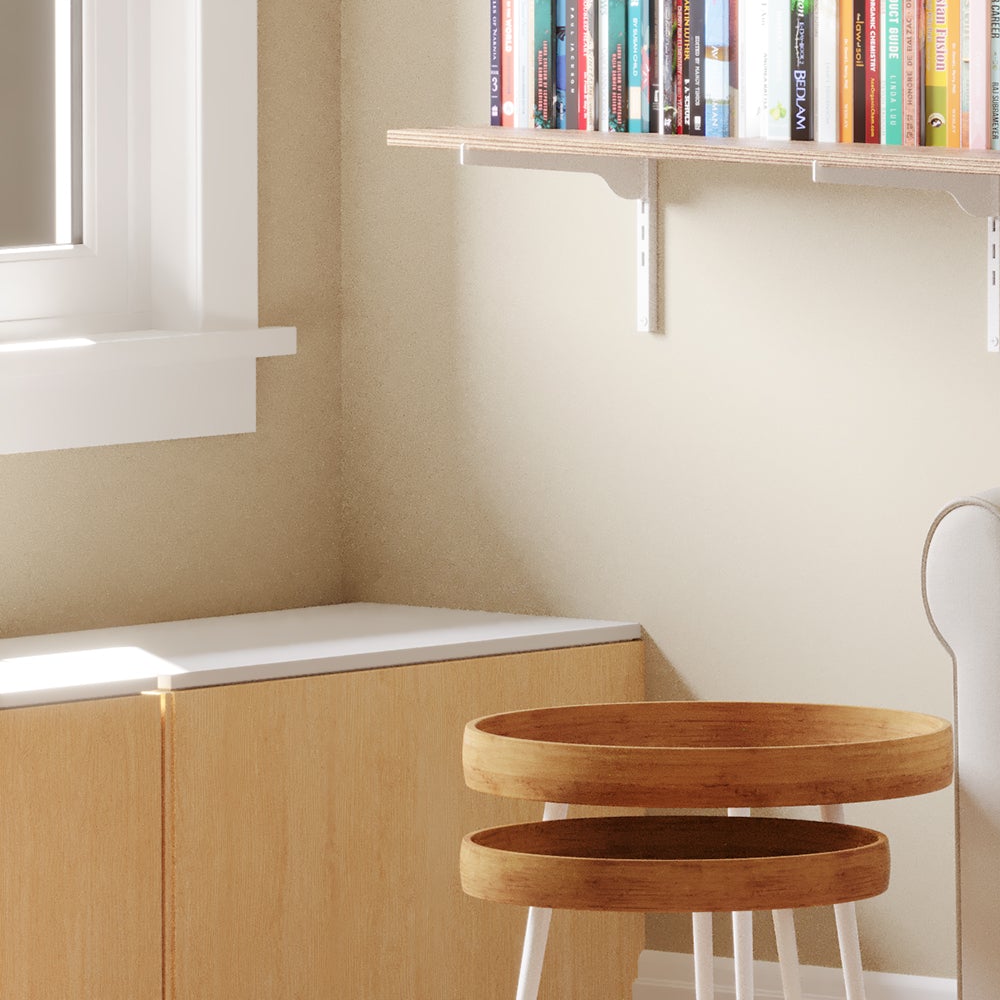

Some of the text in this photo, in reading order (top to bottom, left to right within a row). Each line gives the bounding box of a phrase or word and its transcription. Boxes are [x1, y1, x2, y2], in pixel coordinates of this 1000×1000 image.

[991, 4, 1000, 39] CAREER
[888, 27, 899, 59] GUIDE
[935, 28, 947, 71] Fusion
[794, 69, 806, 130] BEDLAM
